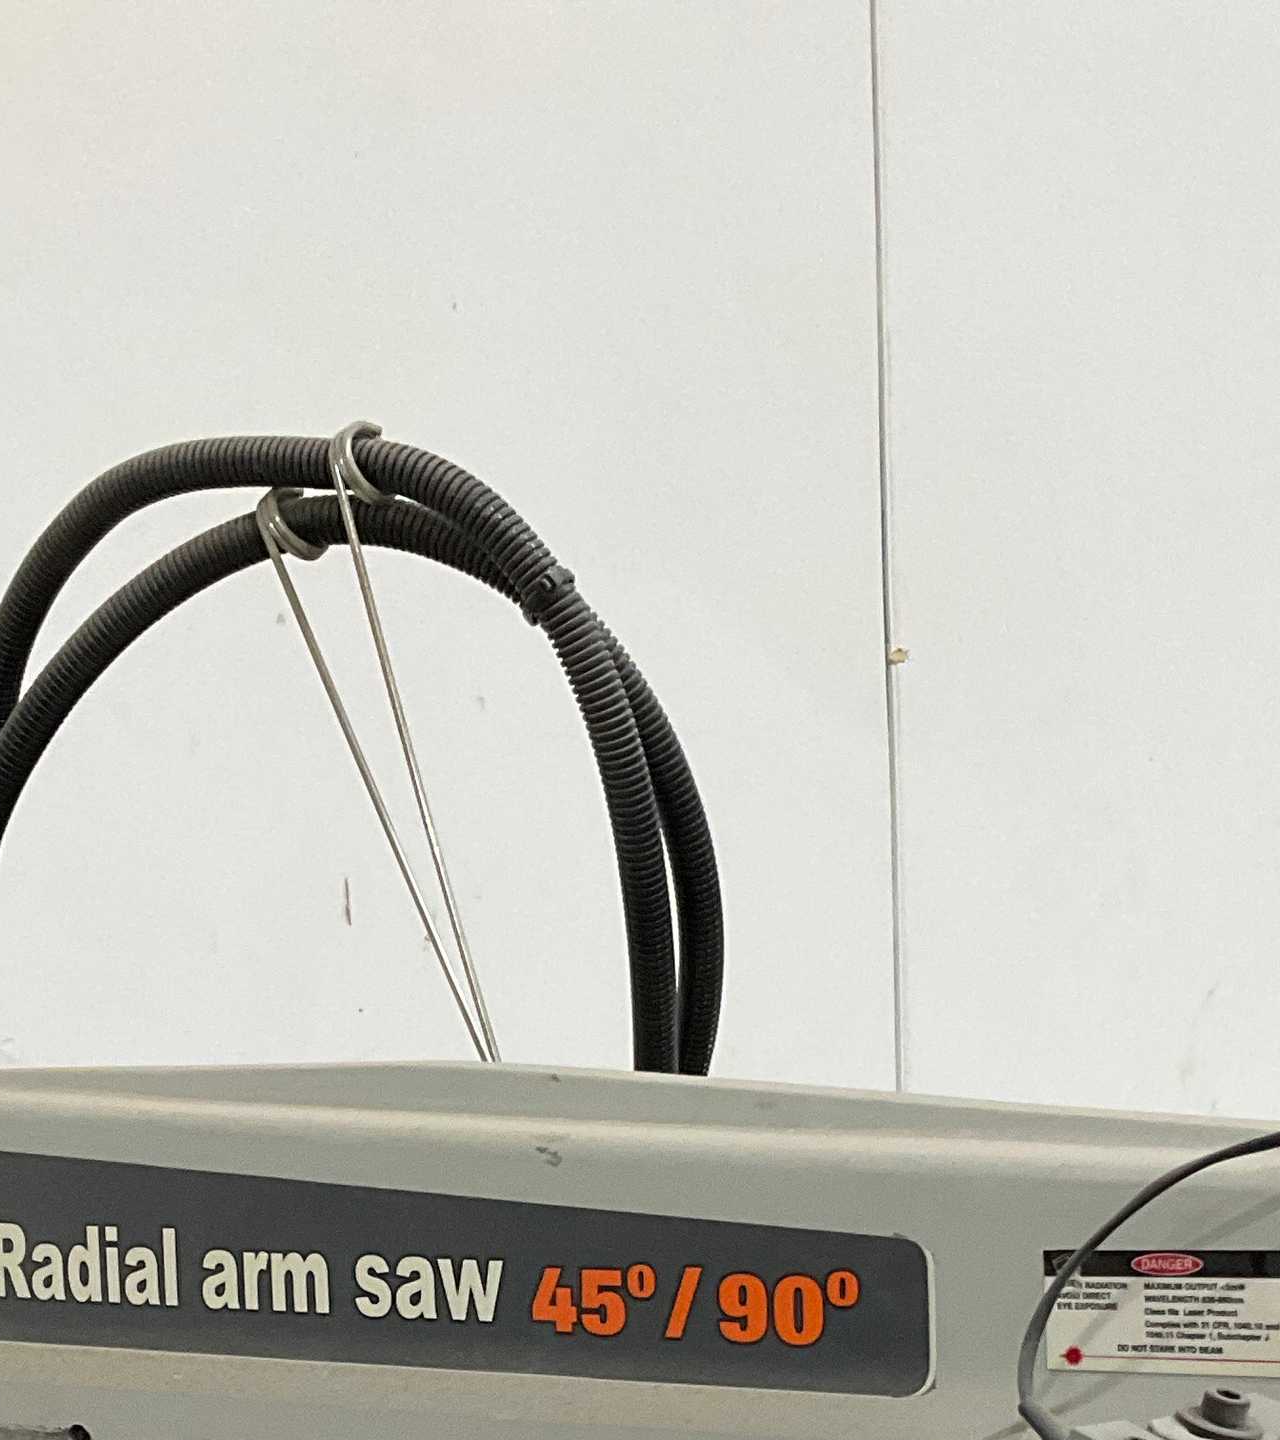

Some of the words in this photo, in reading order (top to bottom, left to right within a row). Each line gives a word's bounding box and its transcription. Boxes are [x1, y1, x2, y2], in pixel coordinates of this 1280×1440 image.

[201, 1248, 331, 1315] arm
[354, 1253, 504, 1323] saw
[1140, 1258, 1194, 1271] DANGER
